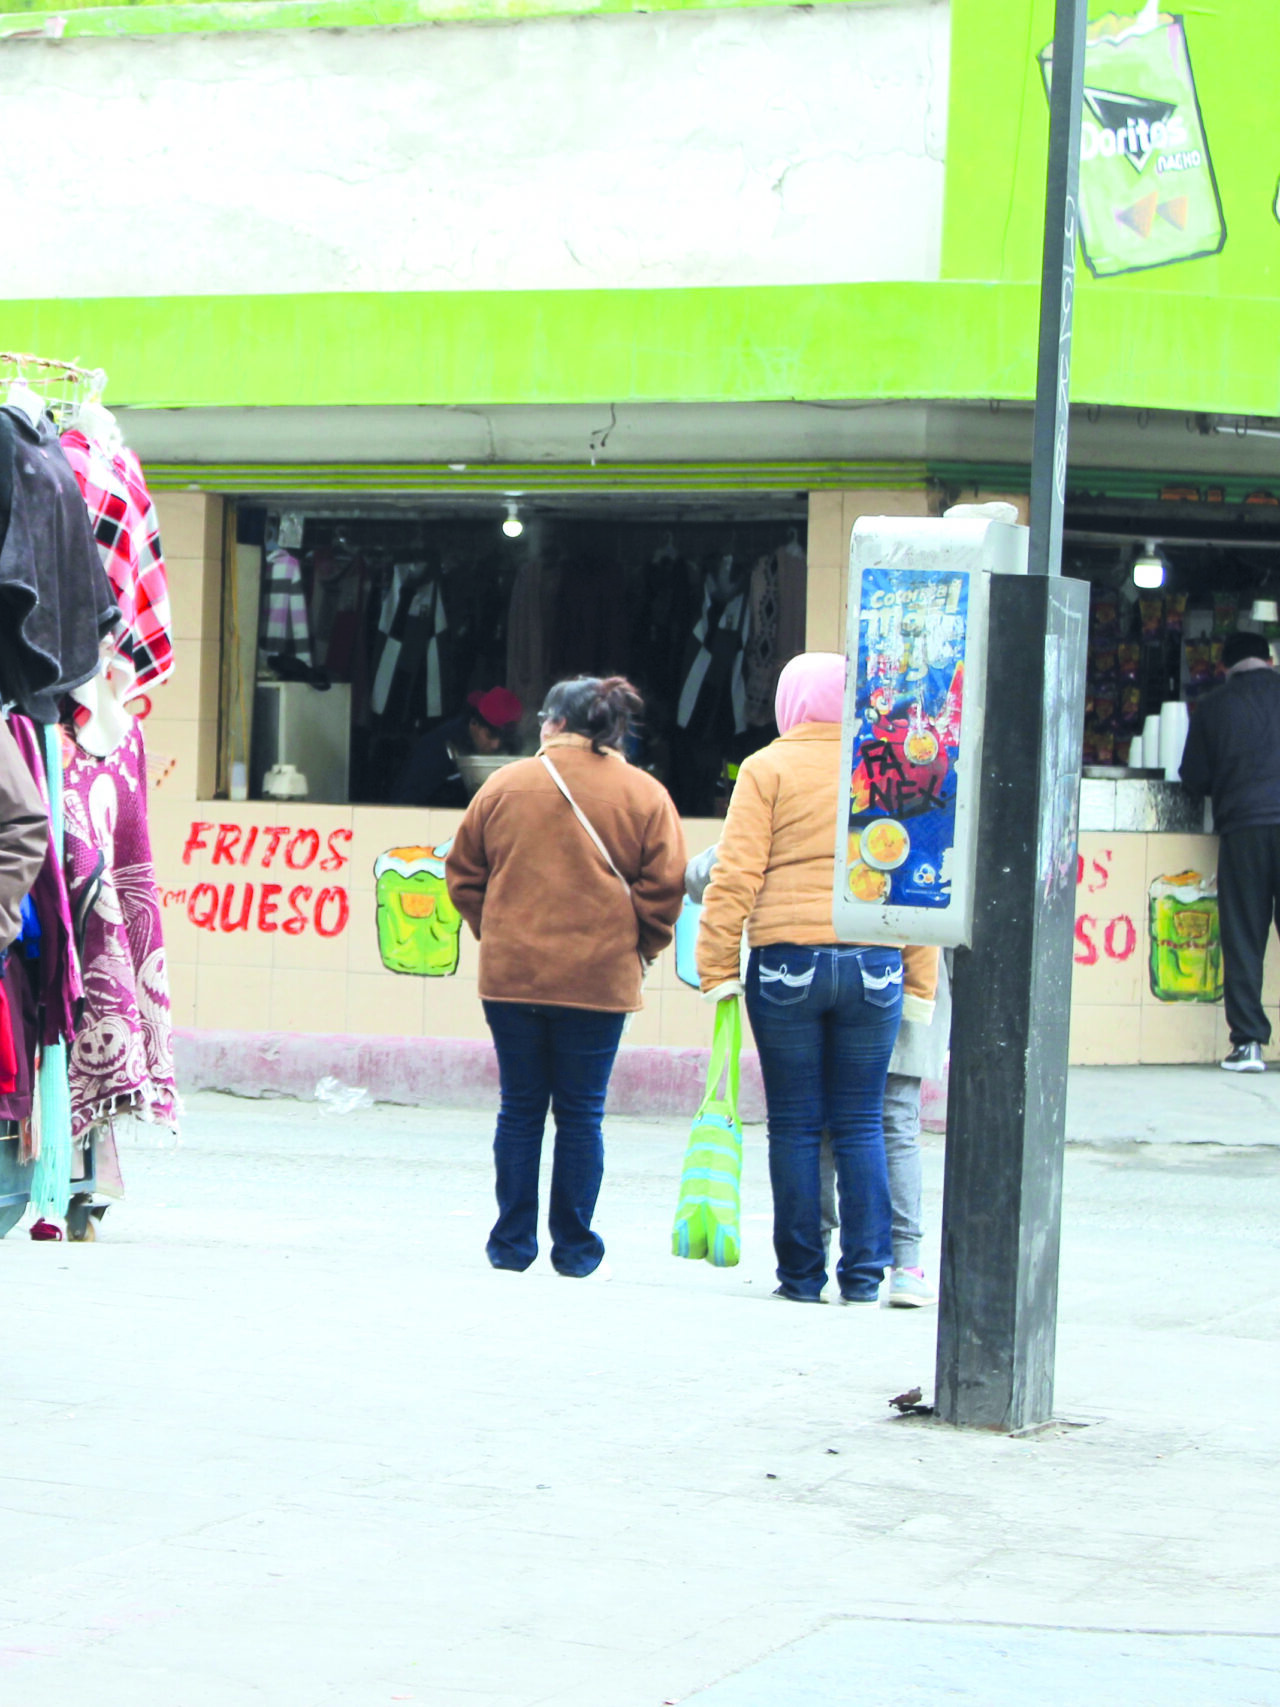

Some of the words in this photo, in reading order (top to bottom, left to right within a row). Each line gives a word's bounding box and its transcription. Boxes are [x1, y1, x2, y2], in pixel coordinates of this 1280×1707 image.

[1079, 115, 1188, 160] Doritos
[182, 821, 353, 872] FRITOS
[187, 882, 350, 938] QUESO
